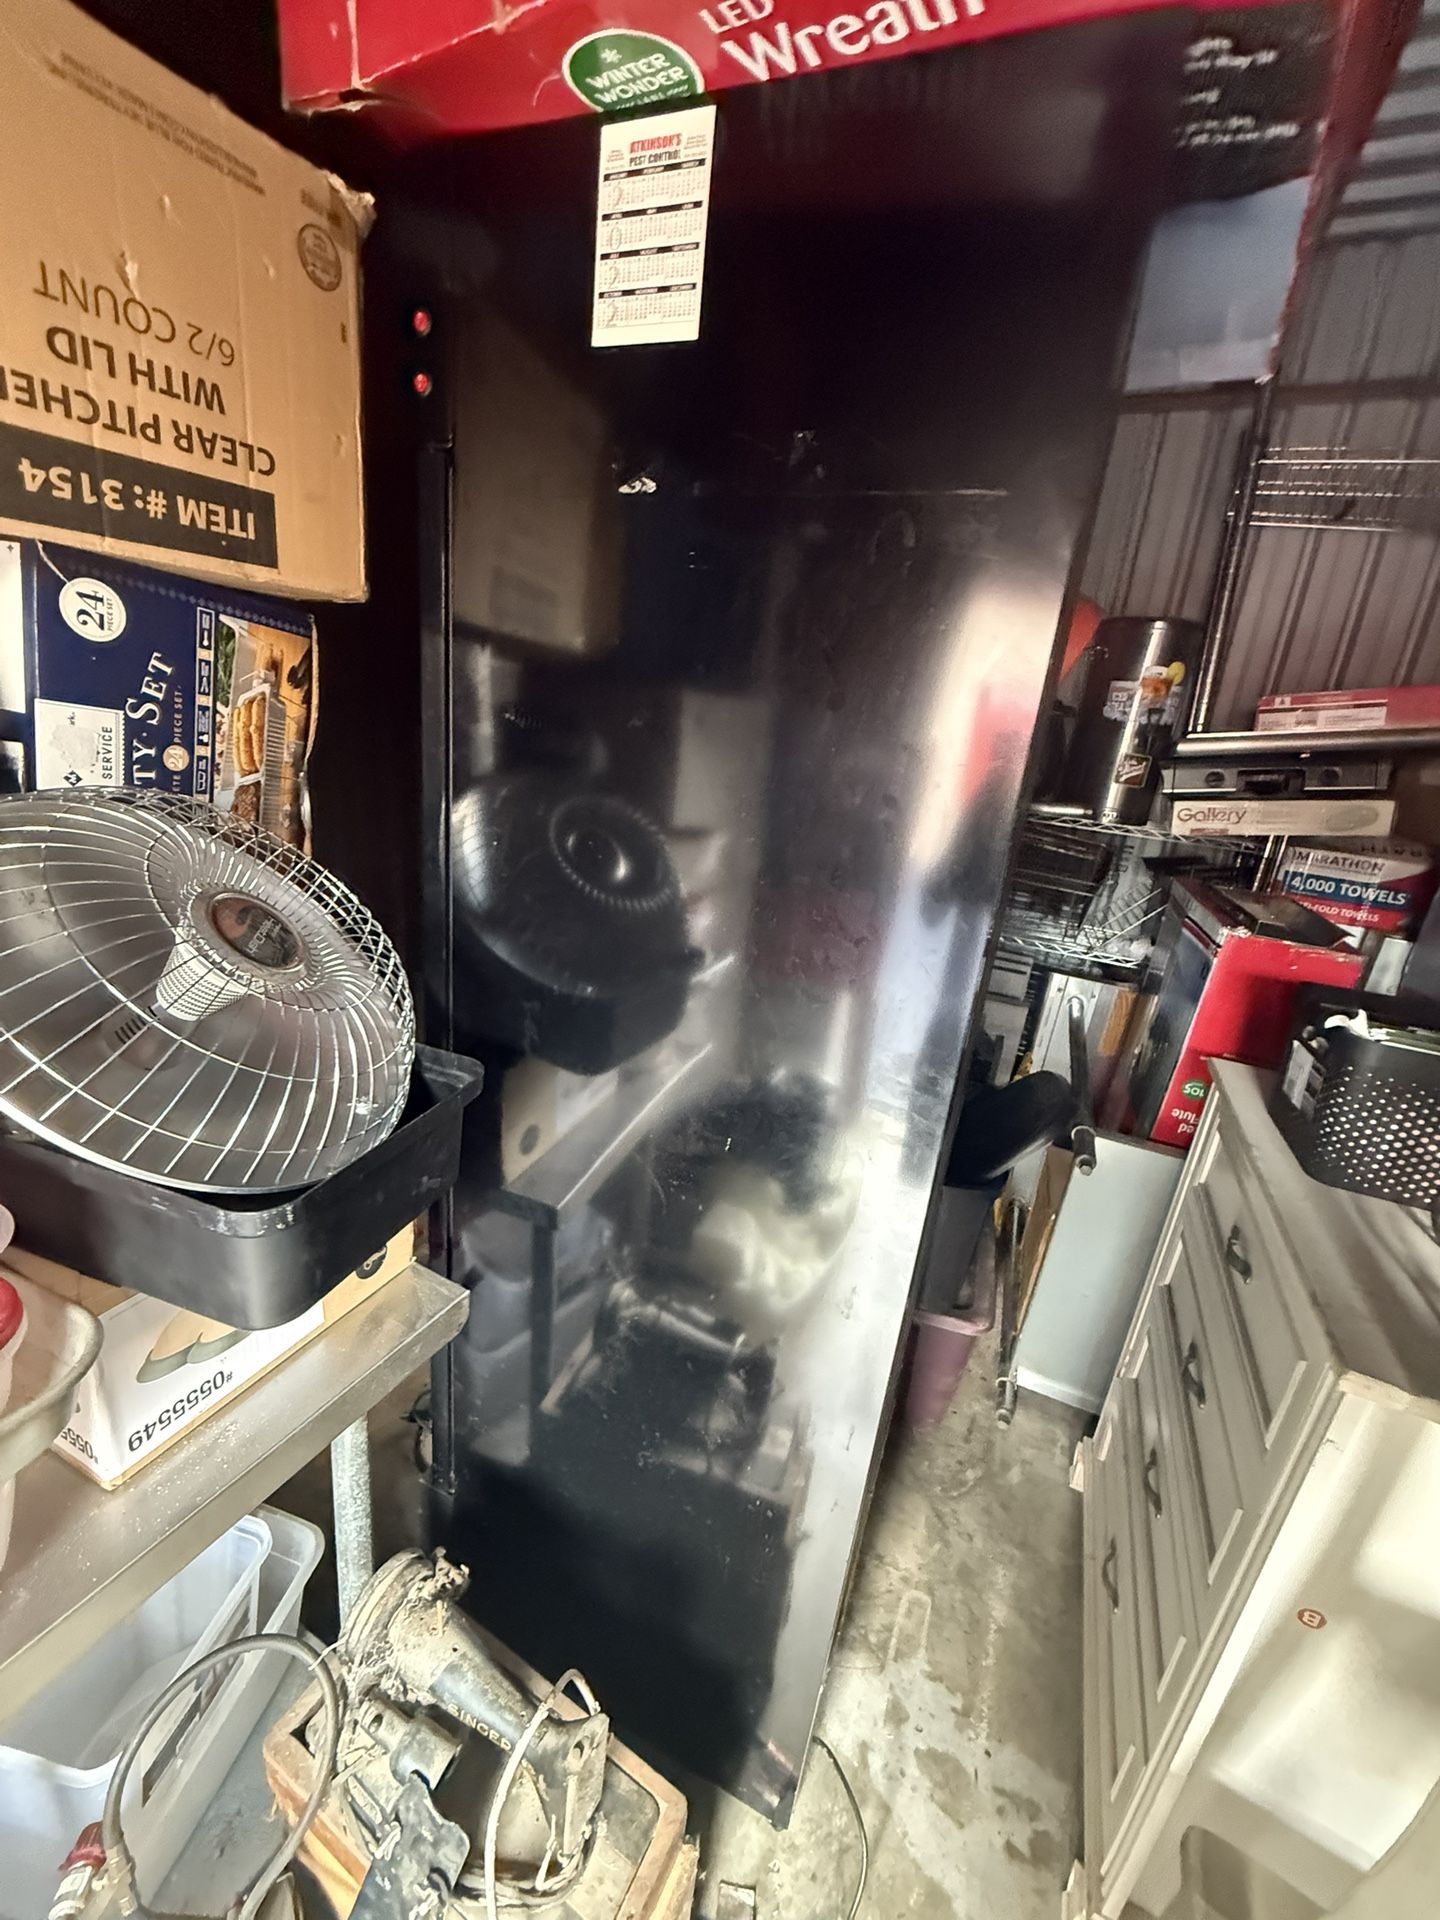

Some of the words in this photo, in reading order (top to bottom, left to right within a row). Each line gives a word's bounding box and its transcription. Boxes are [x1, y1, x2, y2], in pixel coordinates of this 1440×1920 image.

[699, 0, 774, 34] LED
[585, 53, 671, 89] WINTER
[594, 66, 689, 104] WONDER
[629, 133, 682, 154] ATKINSON'S
[629, 154, 647, 168] PEST
[33, 260, 177, 344] COUNT
[46, 326, 117, 379] LID
[186, 322, 236, 367] 6/2
[128, 351, 227, 416] WITH
[171, 418, 276, 477] CLEAR
[175, 494, 257, 541] ITEM
[75, 590, 105, 631] 24
[107, 609, 115, 632] PIECE
[125, 652, 173, 726] SET
[174, 690, 184, 710] SET
[173, 713, 183, 744] PIECE
[102, 725, 113, 780] SERVICE
[167, 748, 184, 771] 24
[1176, 806, 1247, 825] Gallery
[1290, 876, 1335, 894] 4,000
[1340, 883, 1407, 905] TOWELS
[127, 1370, 233, 1452] #0555549
[447, 1703, 513, 1755] SINGER
